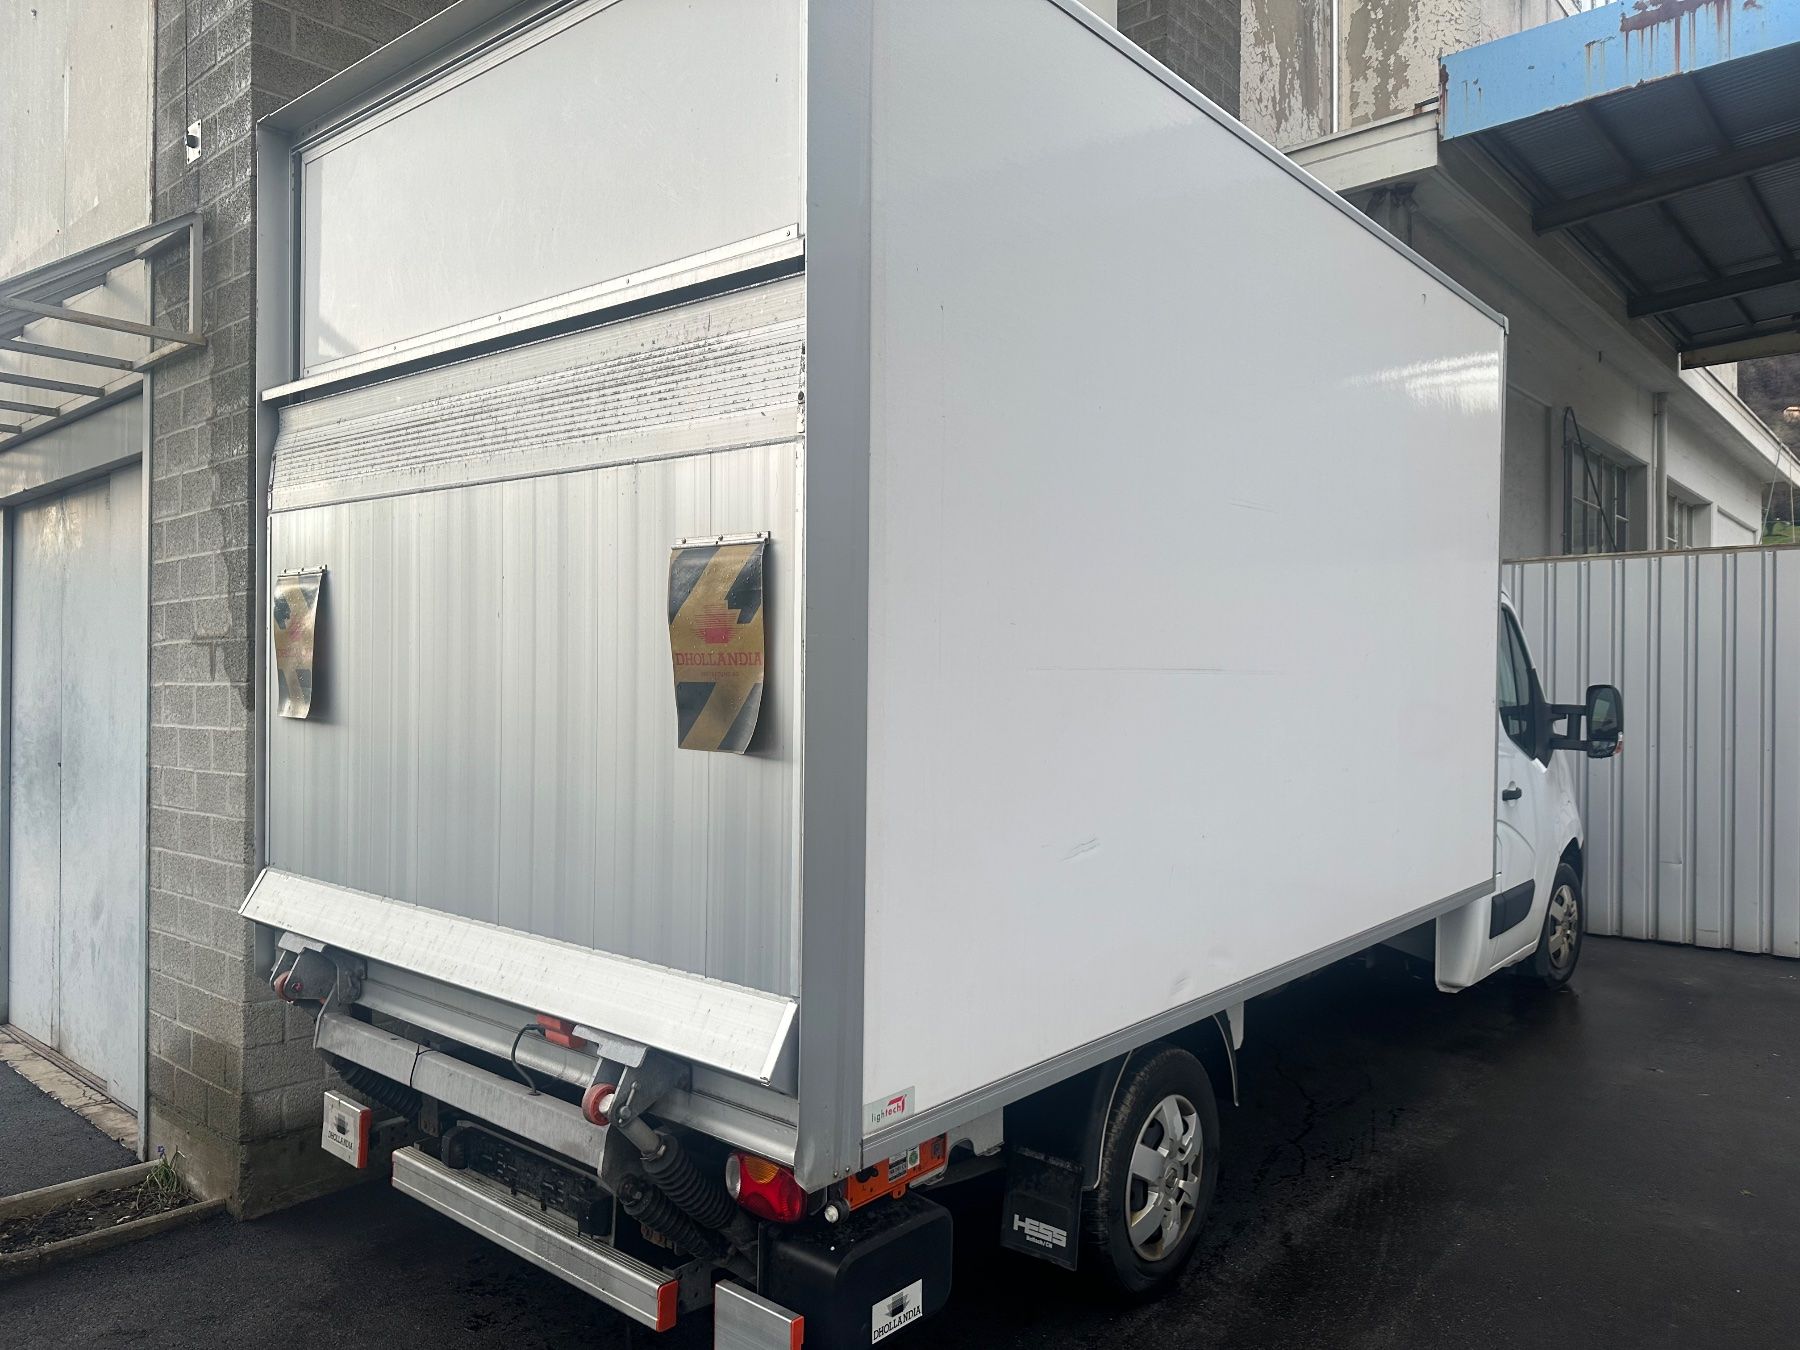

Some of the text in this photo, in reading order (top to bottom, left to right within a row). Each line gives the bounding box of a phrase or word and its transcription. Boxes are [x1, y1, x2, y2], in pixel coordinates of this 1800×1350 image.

[675, 651, 763, 667] DHOLLANDIA
[1013, 1213, 1067, 1248] HESS
[873, 1305, 921, 1341] DHOLLANDIA
